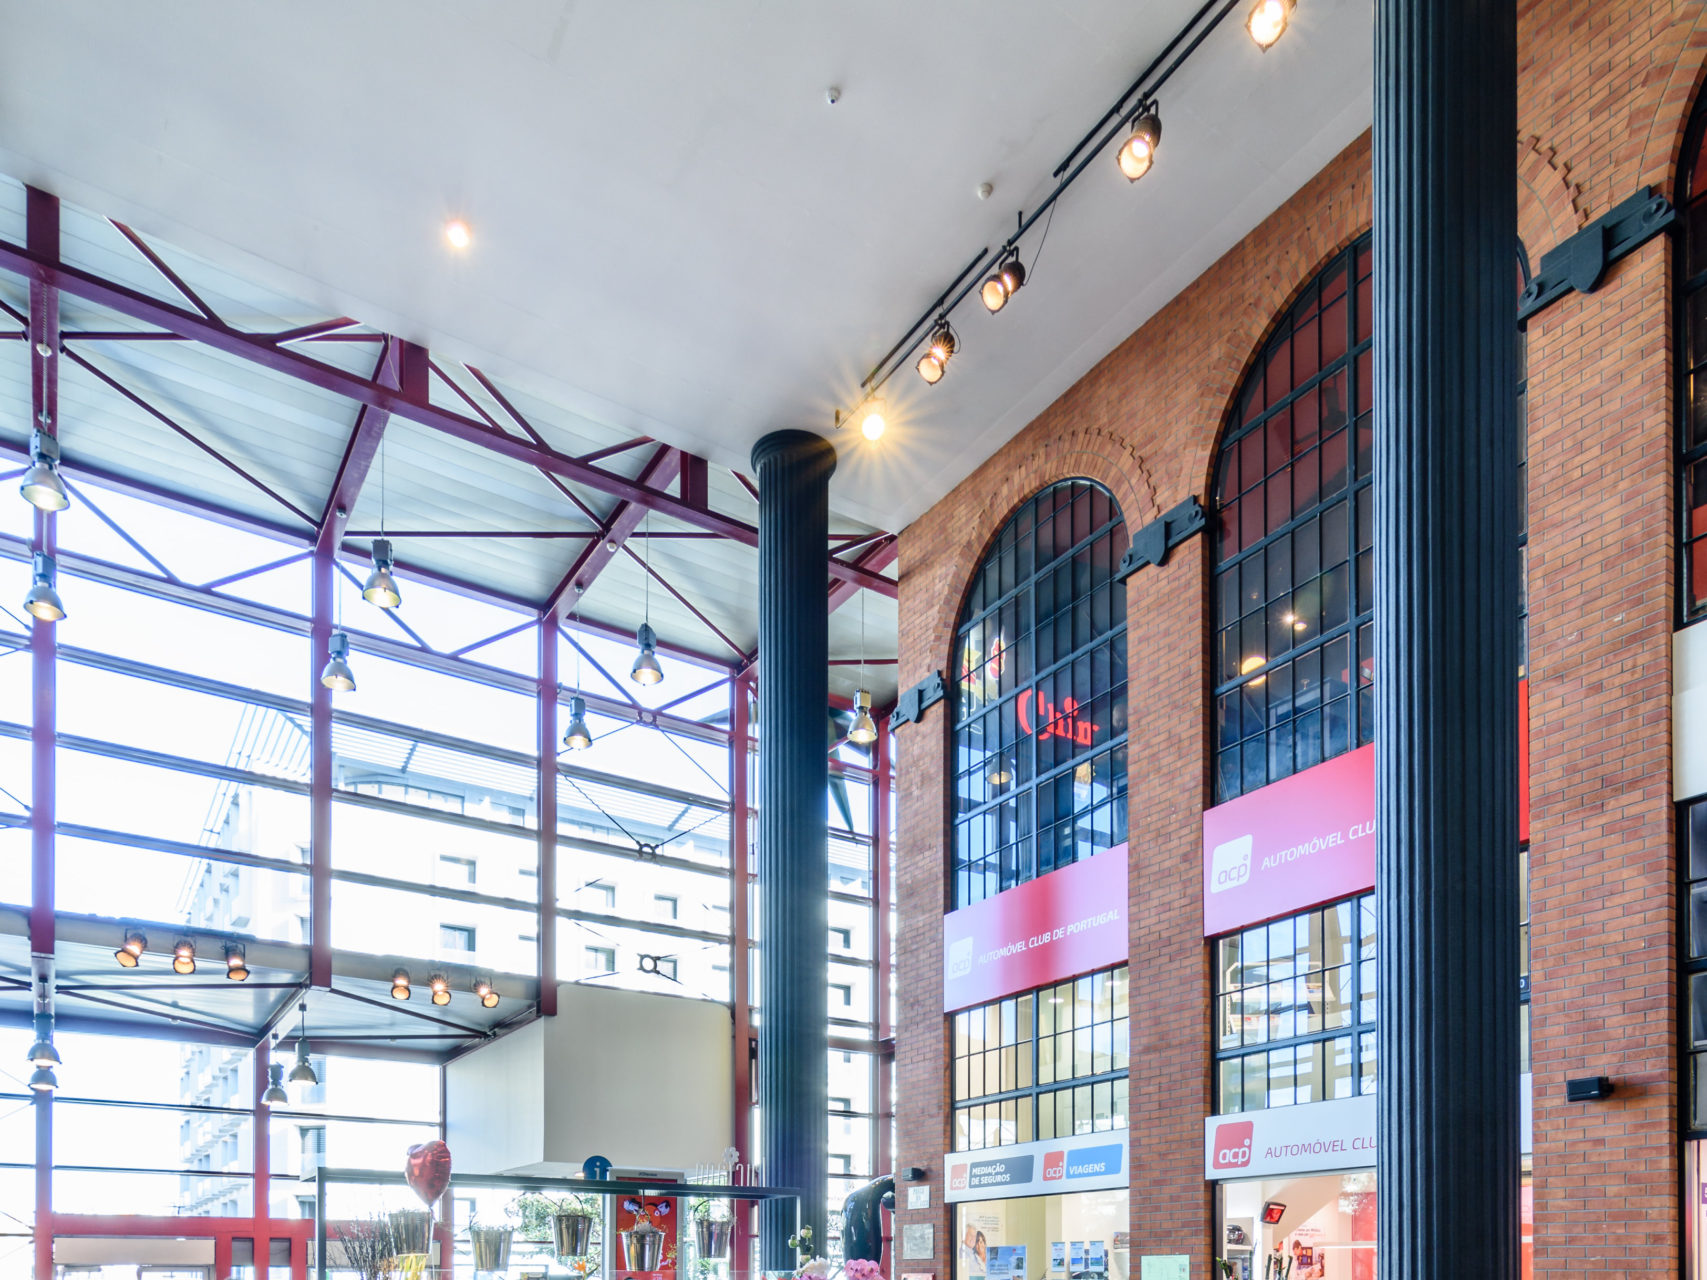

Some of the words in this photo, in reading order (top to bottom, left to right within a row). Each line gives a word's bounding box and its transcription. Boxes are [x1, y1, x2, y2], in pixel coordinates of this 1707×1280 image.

[1261, 831, 1345, 870] AUTOMÓVEL
[1217, 862, 1249, 886] acp
[978, 940, 1027, 965] AUTOMÓVEL
[1028, 931, 1052, 948] CLUB
[1052, 926, 1066, 941] DE
[1066, 909, 1121, 936] PORTUGAL
[1218, 1147, 1250, 1165] acp
[1264, 1138, 1347, 1159] AUTOMÓVEL
[971, 1162, 1006, 1176] MEDIAÇÃO
[1045, 1167, 1064, 1179] acp
[1069, 1162, 1106, 1176] VIAGENS
[952, 1176, 967, 1189] acp
[971, 1177, 981, 1186] DE
[981, 1174, 1011, 1184] SEGUROS
